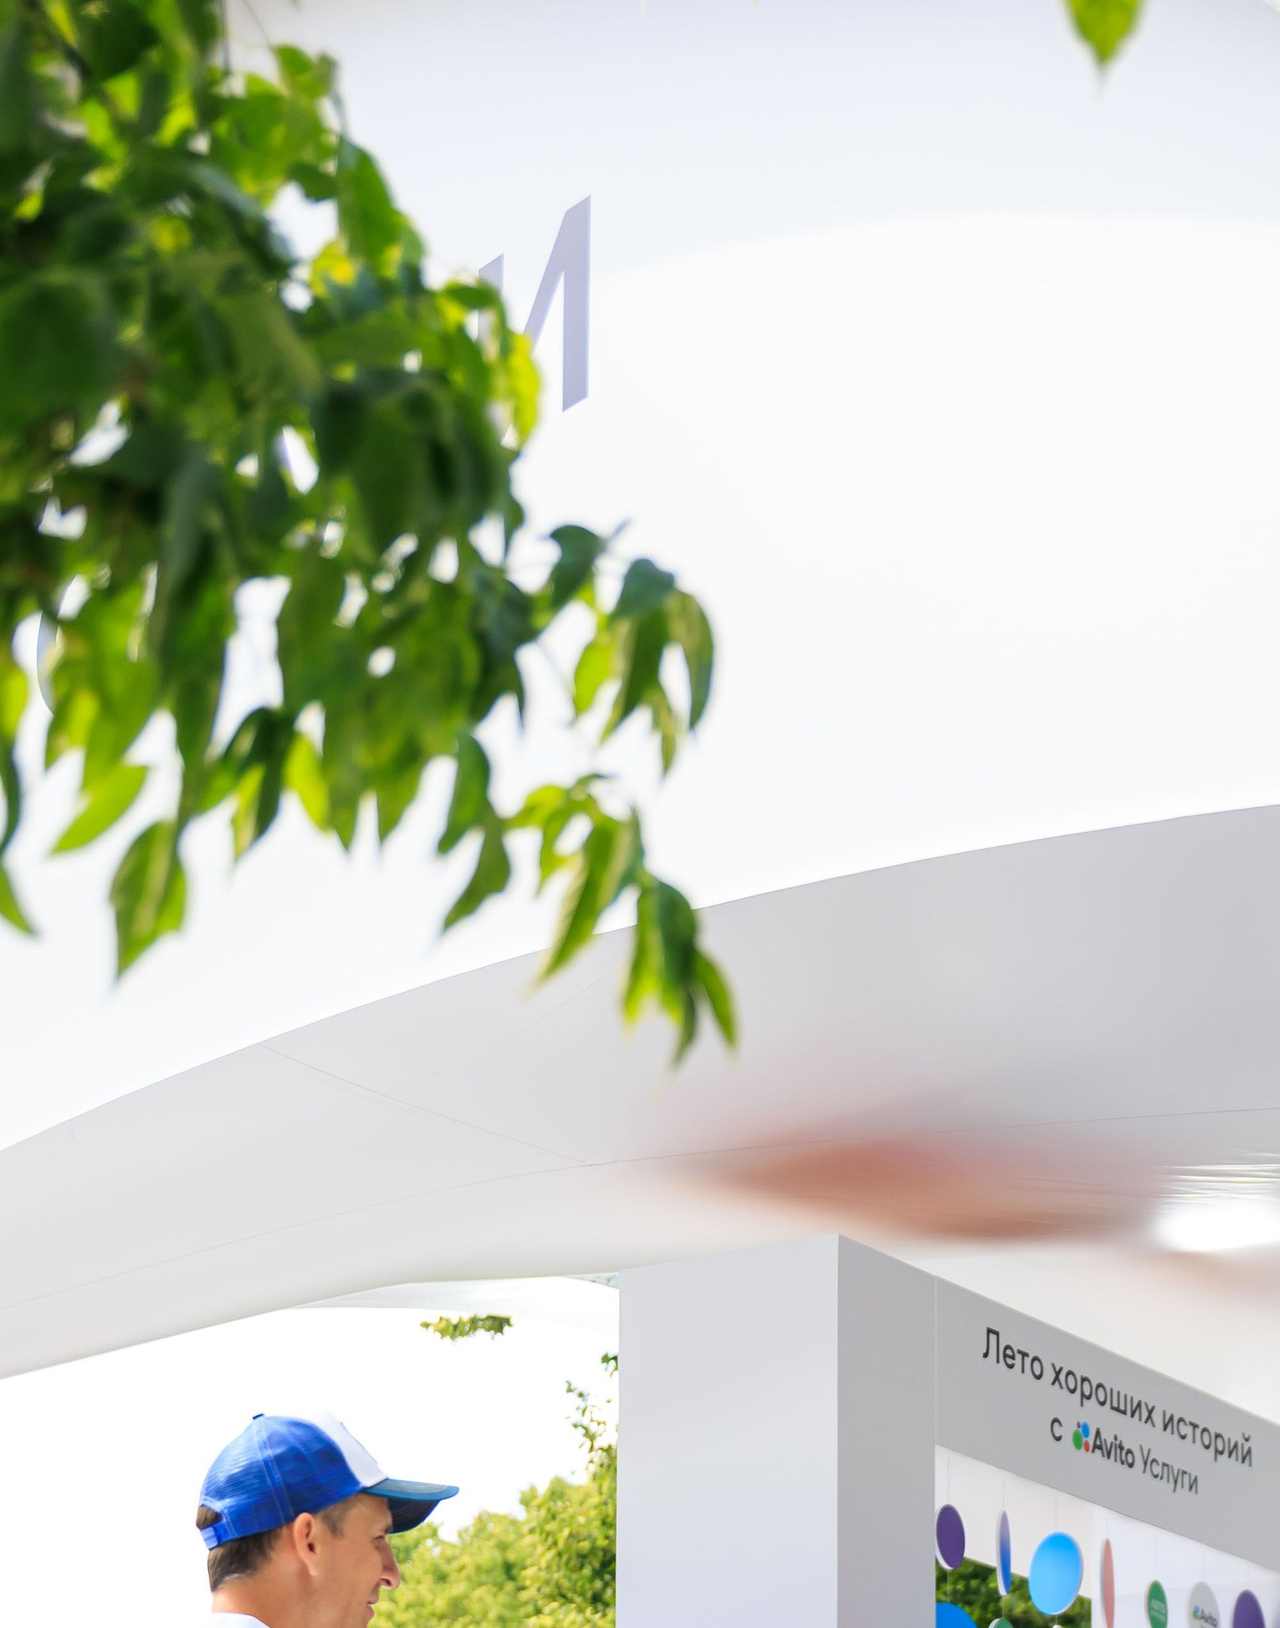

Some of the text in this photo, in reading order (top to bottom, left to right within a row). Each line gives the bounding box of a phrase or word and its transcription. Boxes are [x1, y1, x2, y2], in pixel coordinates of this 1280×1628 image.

[982, 1326, 1253, 1467] Лето хороших историй
[1091, 1427, 1135, 1468] Avito
[1139, 1444, 1199, 1494] Услуги
